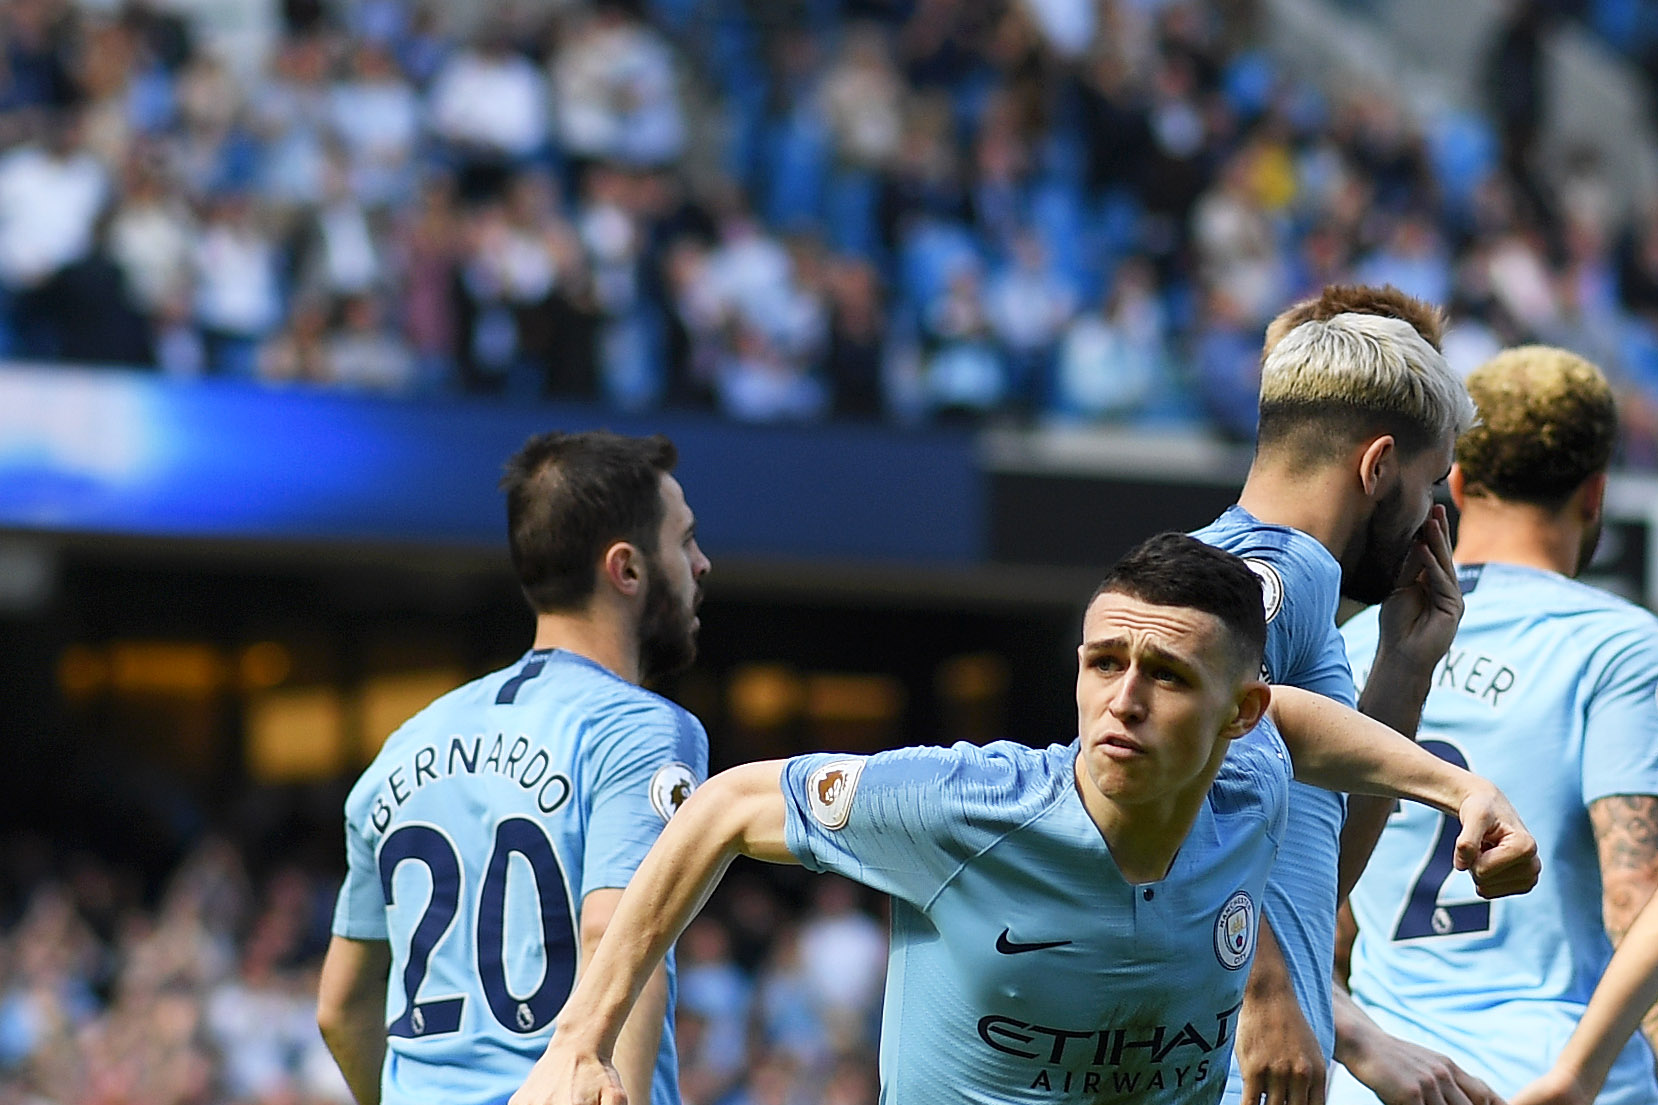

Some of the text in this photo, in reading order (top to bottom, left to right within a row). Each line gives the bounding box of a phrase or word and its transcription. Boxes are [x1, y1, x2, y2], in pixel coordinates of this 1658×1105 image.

[1438, 650, 1516, 707] KER
[371, 733, 572, 834] BERNARDO
[1393, 739, 1491, 941] 2
[378, 816, 579, 1038] 20
[1031, 1059, 1209, 1093] AIRWAYS
